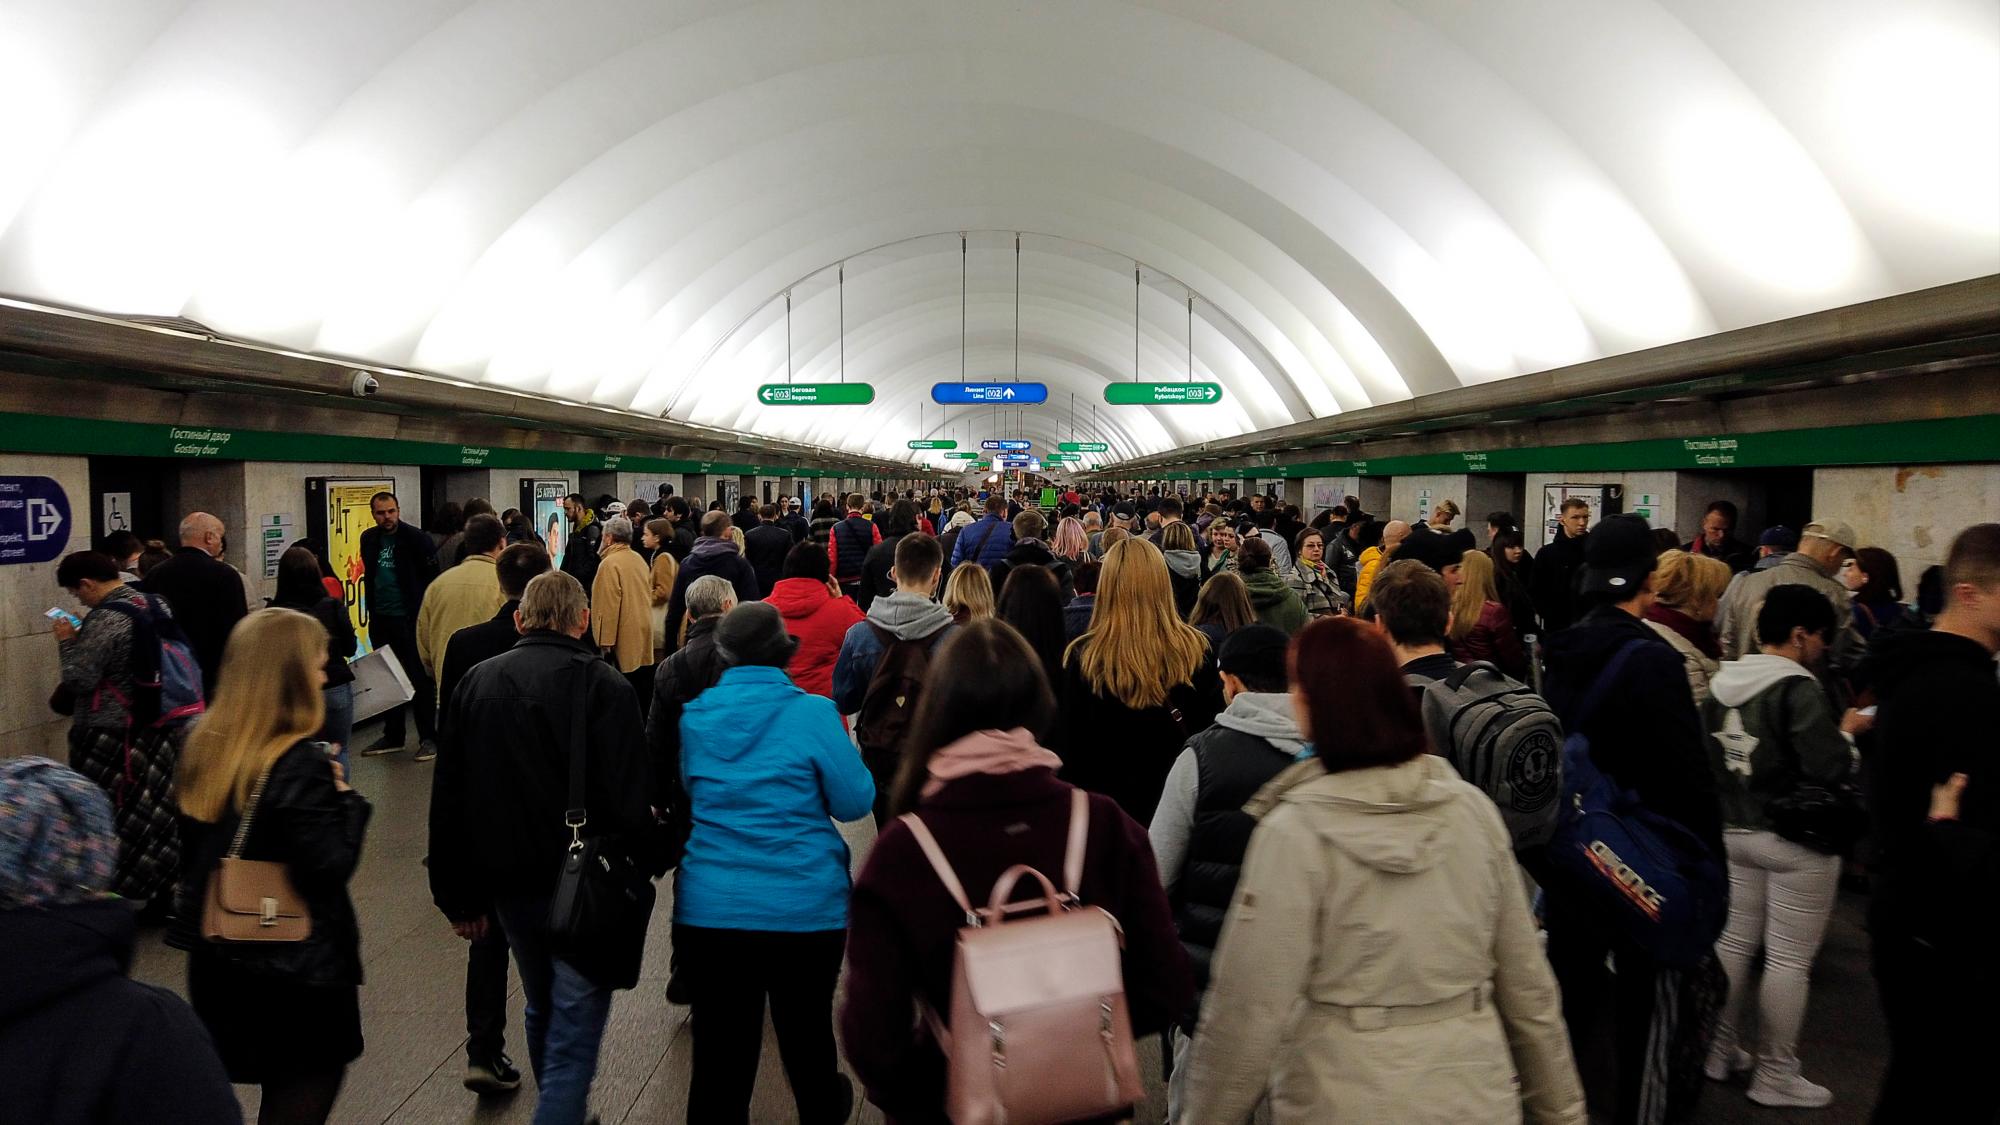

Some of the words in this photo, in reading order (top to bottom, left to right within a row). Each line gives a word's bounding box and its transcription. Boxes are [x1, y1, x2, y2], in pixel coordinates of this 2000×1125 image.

[170, 427, 211, 440] Гостиный
[209, 432, 231, 444] двор
[174, 443, 203, 457] Gostiny
[202, 444, 219, 455] dvor
